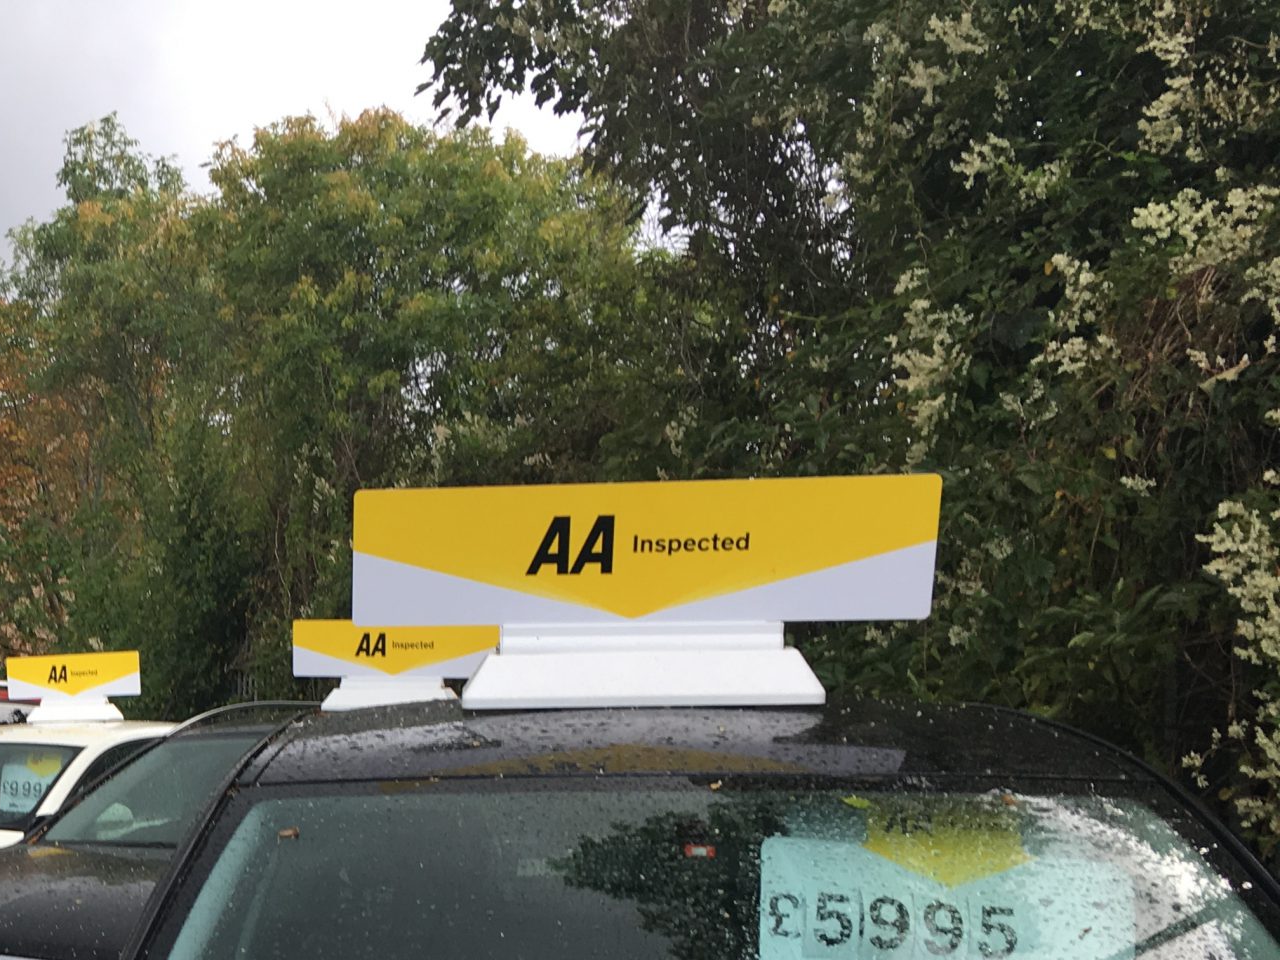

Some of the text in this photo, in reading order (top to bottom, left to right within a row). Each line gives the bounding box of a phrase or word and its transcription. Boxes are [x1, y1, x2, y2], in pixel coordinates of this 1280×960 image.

[525, 514, 750, 576] AA Inspected
[355, 632, 434, 657] AA Inspected
[47, 664, 68, 684] AA
[768, 890, 1018, 959] £5995
